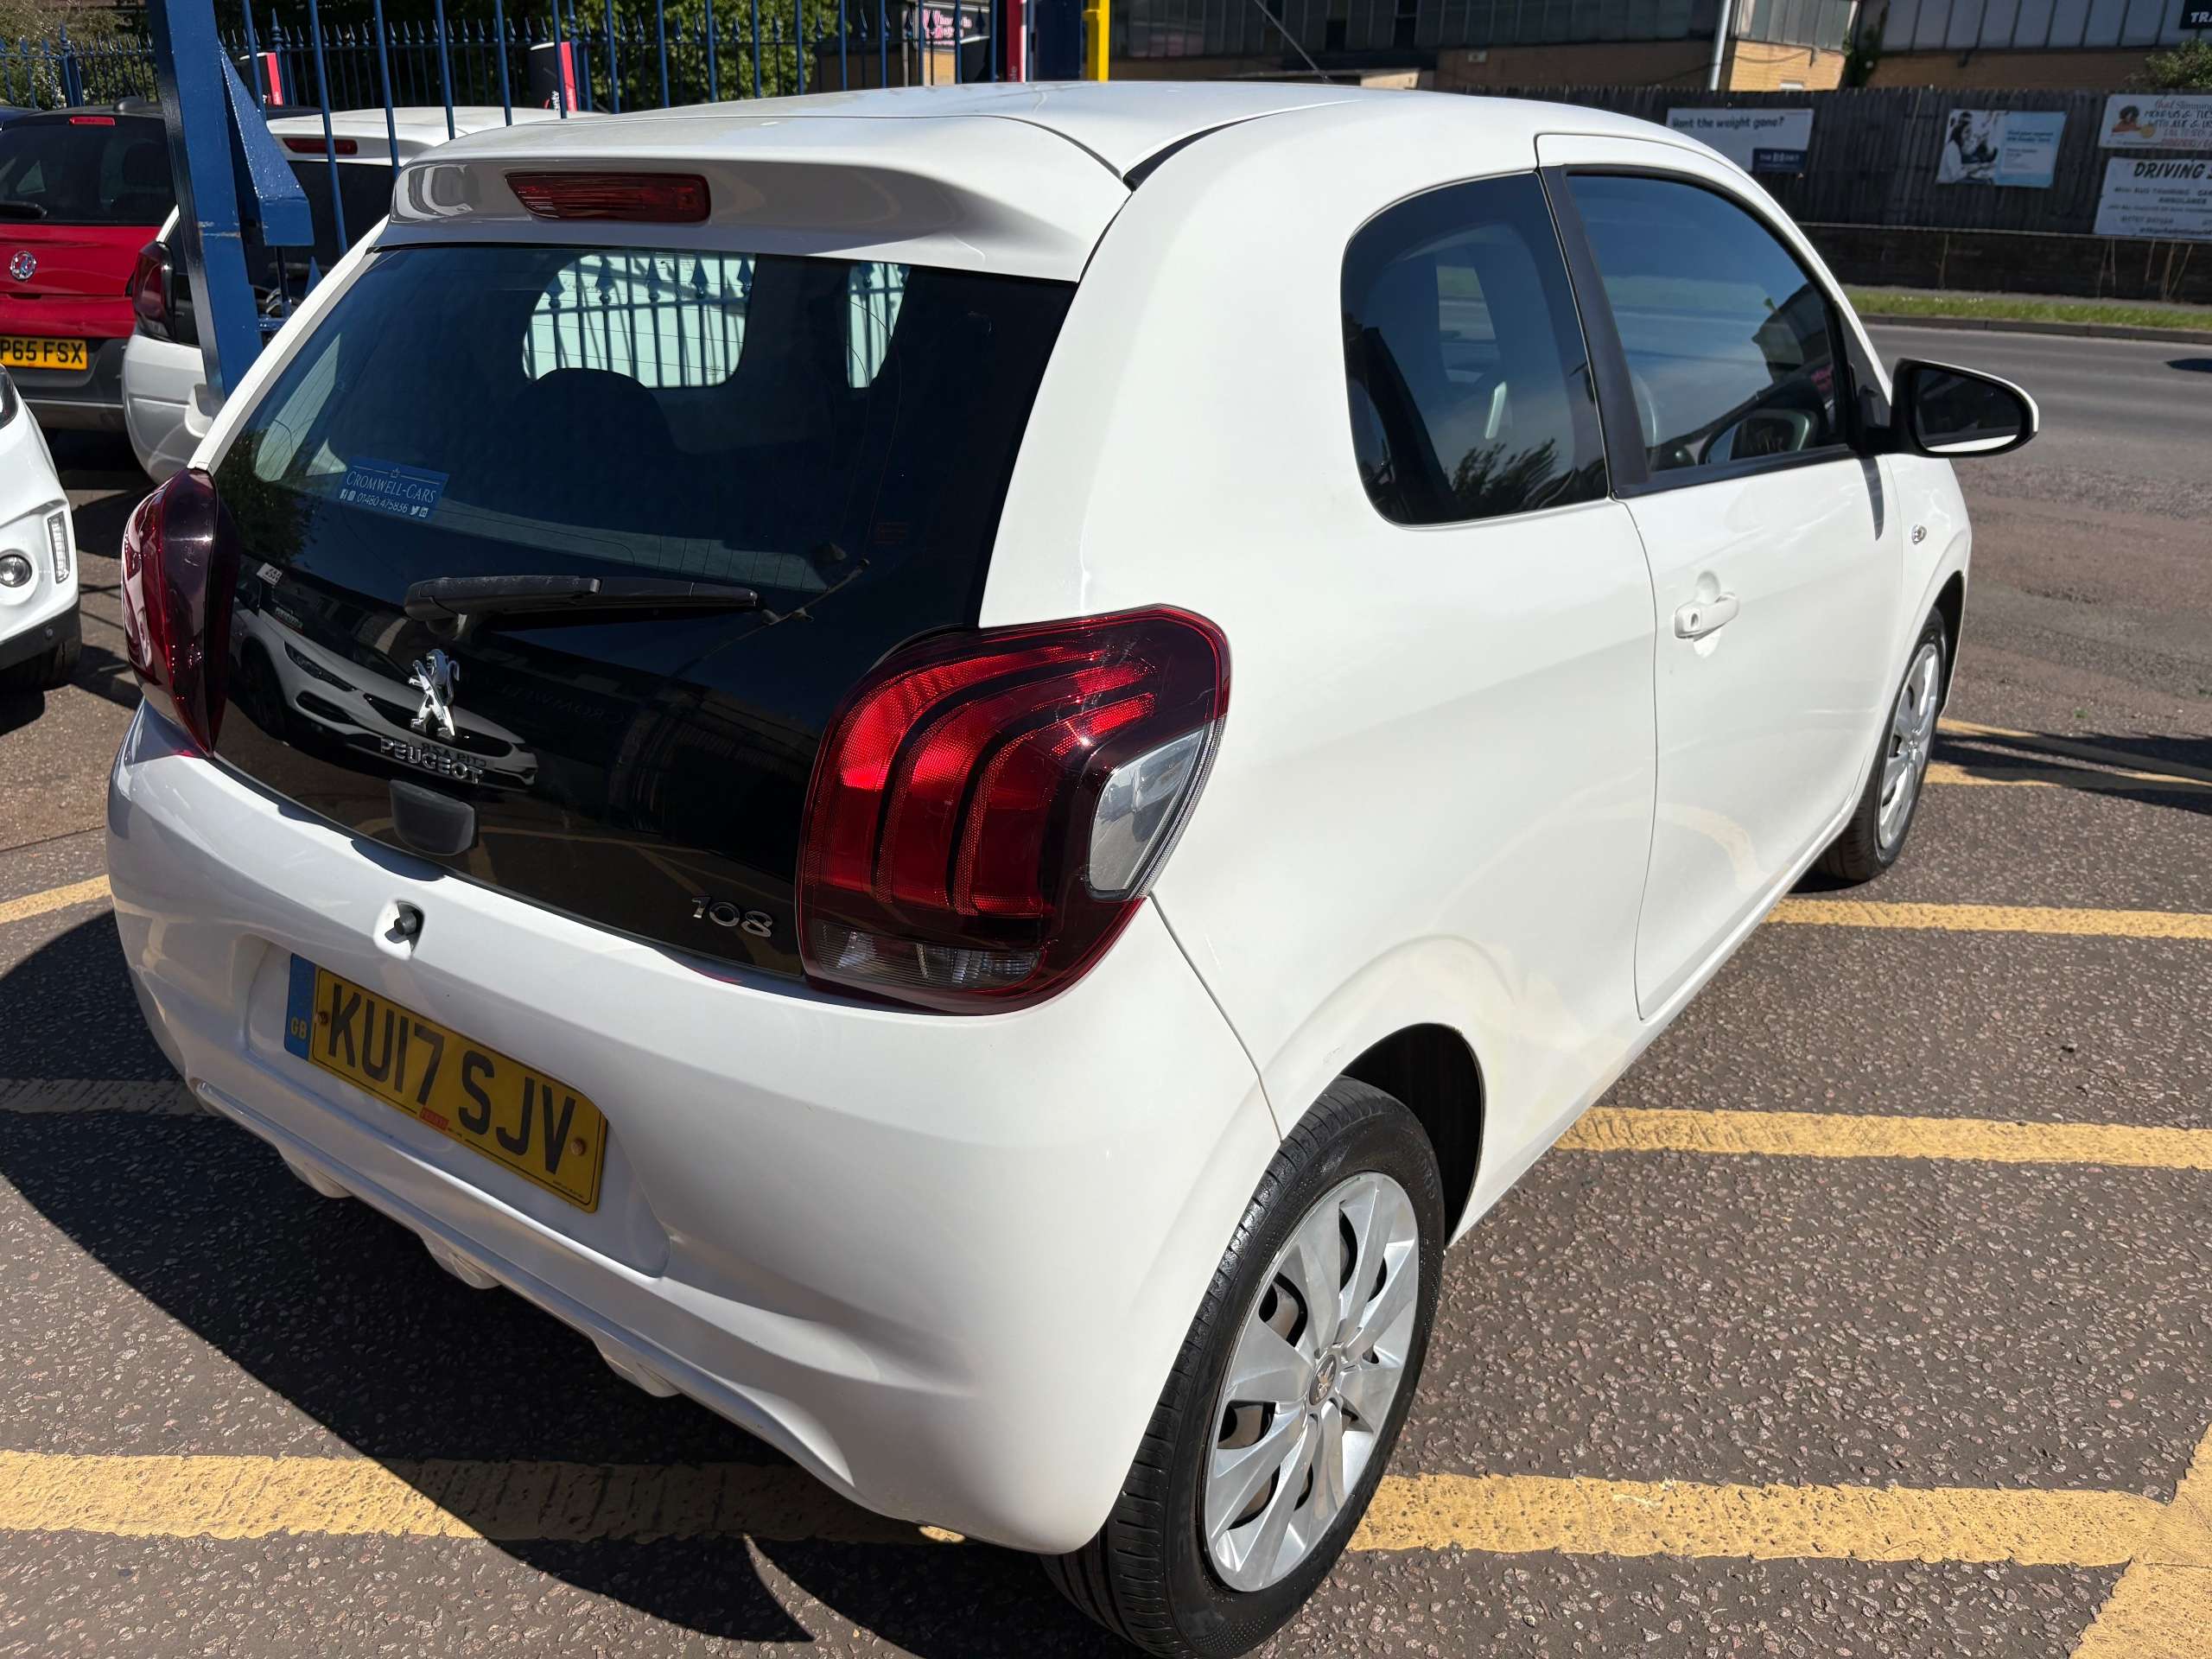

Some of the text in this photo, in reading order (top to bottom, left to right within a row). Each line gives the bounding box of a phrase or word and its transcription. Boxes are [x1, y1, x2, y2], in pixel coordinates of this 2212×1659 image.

[1697, 118, 1713, 128] the
[1716, 117, 1751, 130] weight
[1753, 116, 1785, 130] gone?
[2133, 161, 2205, 180] DRIVING
[43, 341, 83, 364] FSX
[346, 471, 436, 504] CROMWELL-CARS
[357, 492, 380, 506] 01480
[380, 737, 484, 784] PEUGEOT
[691, 896, 773, 938] 108
[290, 1017, 308, 1040] GB
[328, 982, 576, 1175] KU17 SJV
